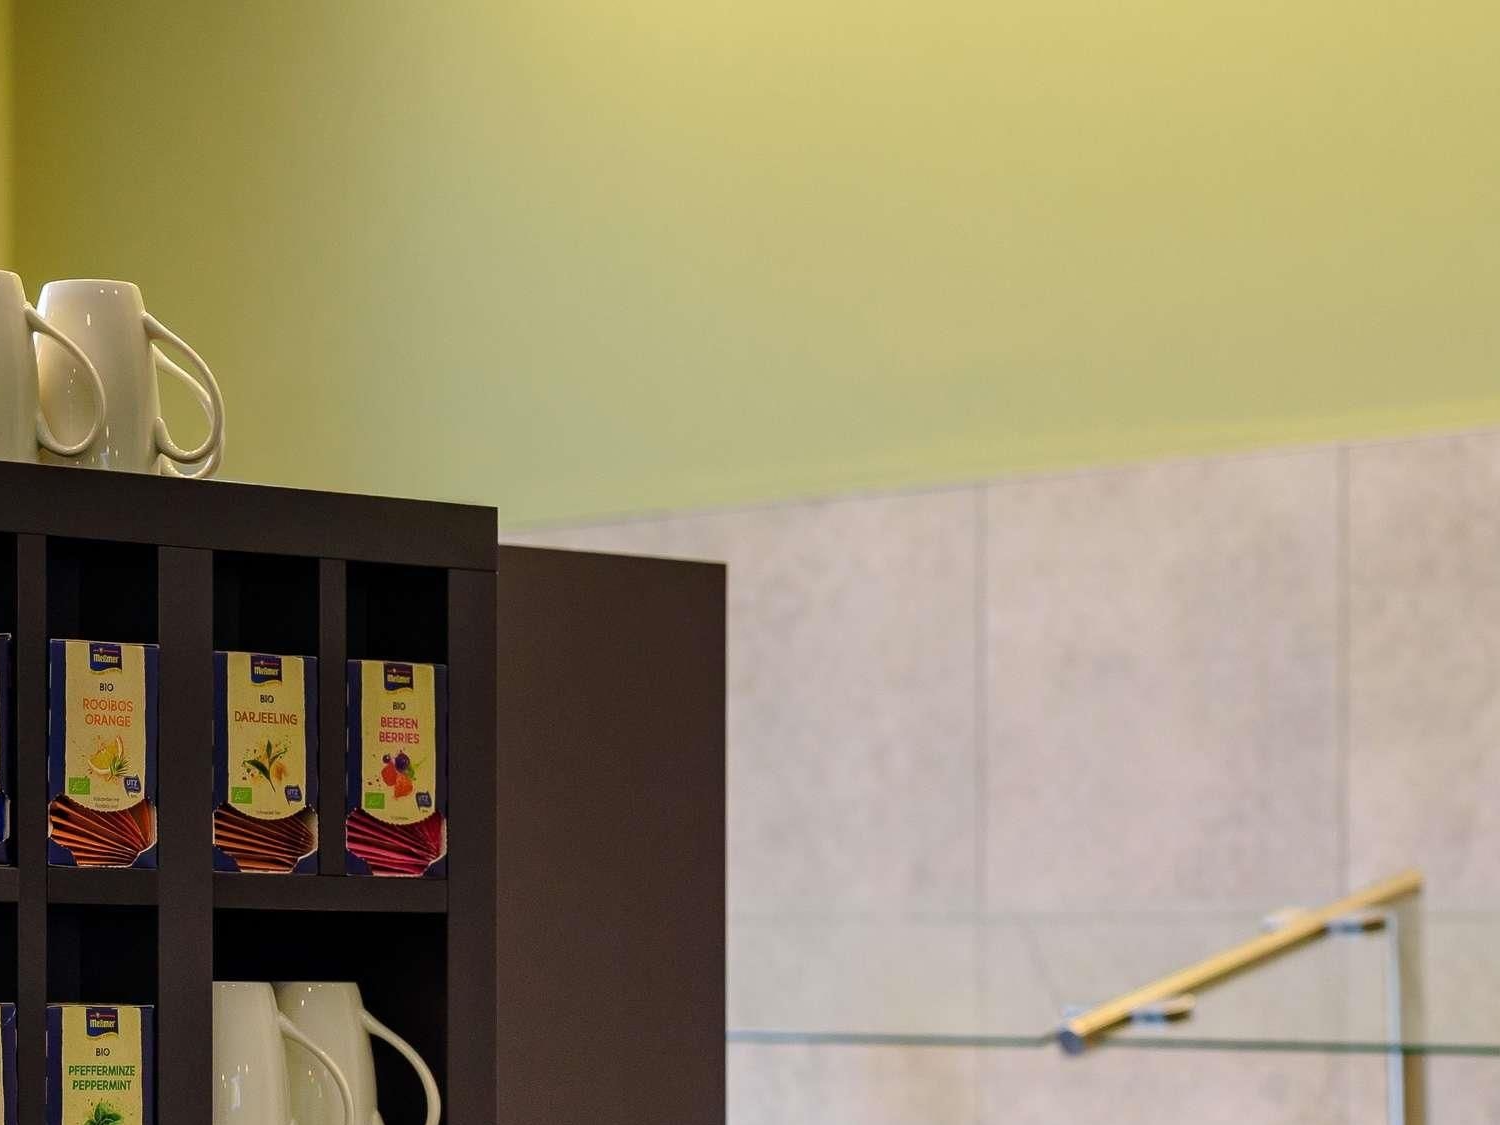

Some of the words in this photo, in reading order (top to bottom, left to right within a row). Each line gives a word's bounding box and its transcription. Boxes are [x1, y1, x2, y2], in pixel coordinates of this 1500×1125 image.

[98, 682, 115, 693] BIO
[259, 694, 275, 704] BIO
[82, 698, 134, 713] ROOIBOS
[392, 701, 407, 712] BIO
[84, 714, 133, 728] ORANGE
[234, 710, 299, 726] DARJEELING
[380, 717, 419, 730] BEEREN
[379, 731, 421, 745] BERRIES
[95, 1047, 111, 1057] BIO
[68, 1065, 136, 1077] PFEFFERMINZE
[72, 1079, 132, 1091] PEPPERMINT
